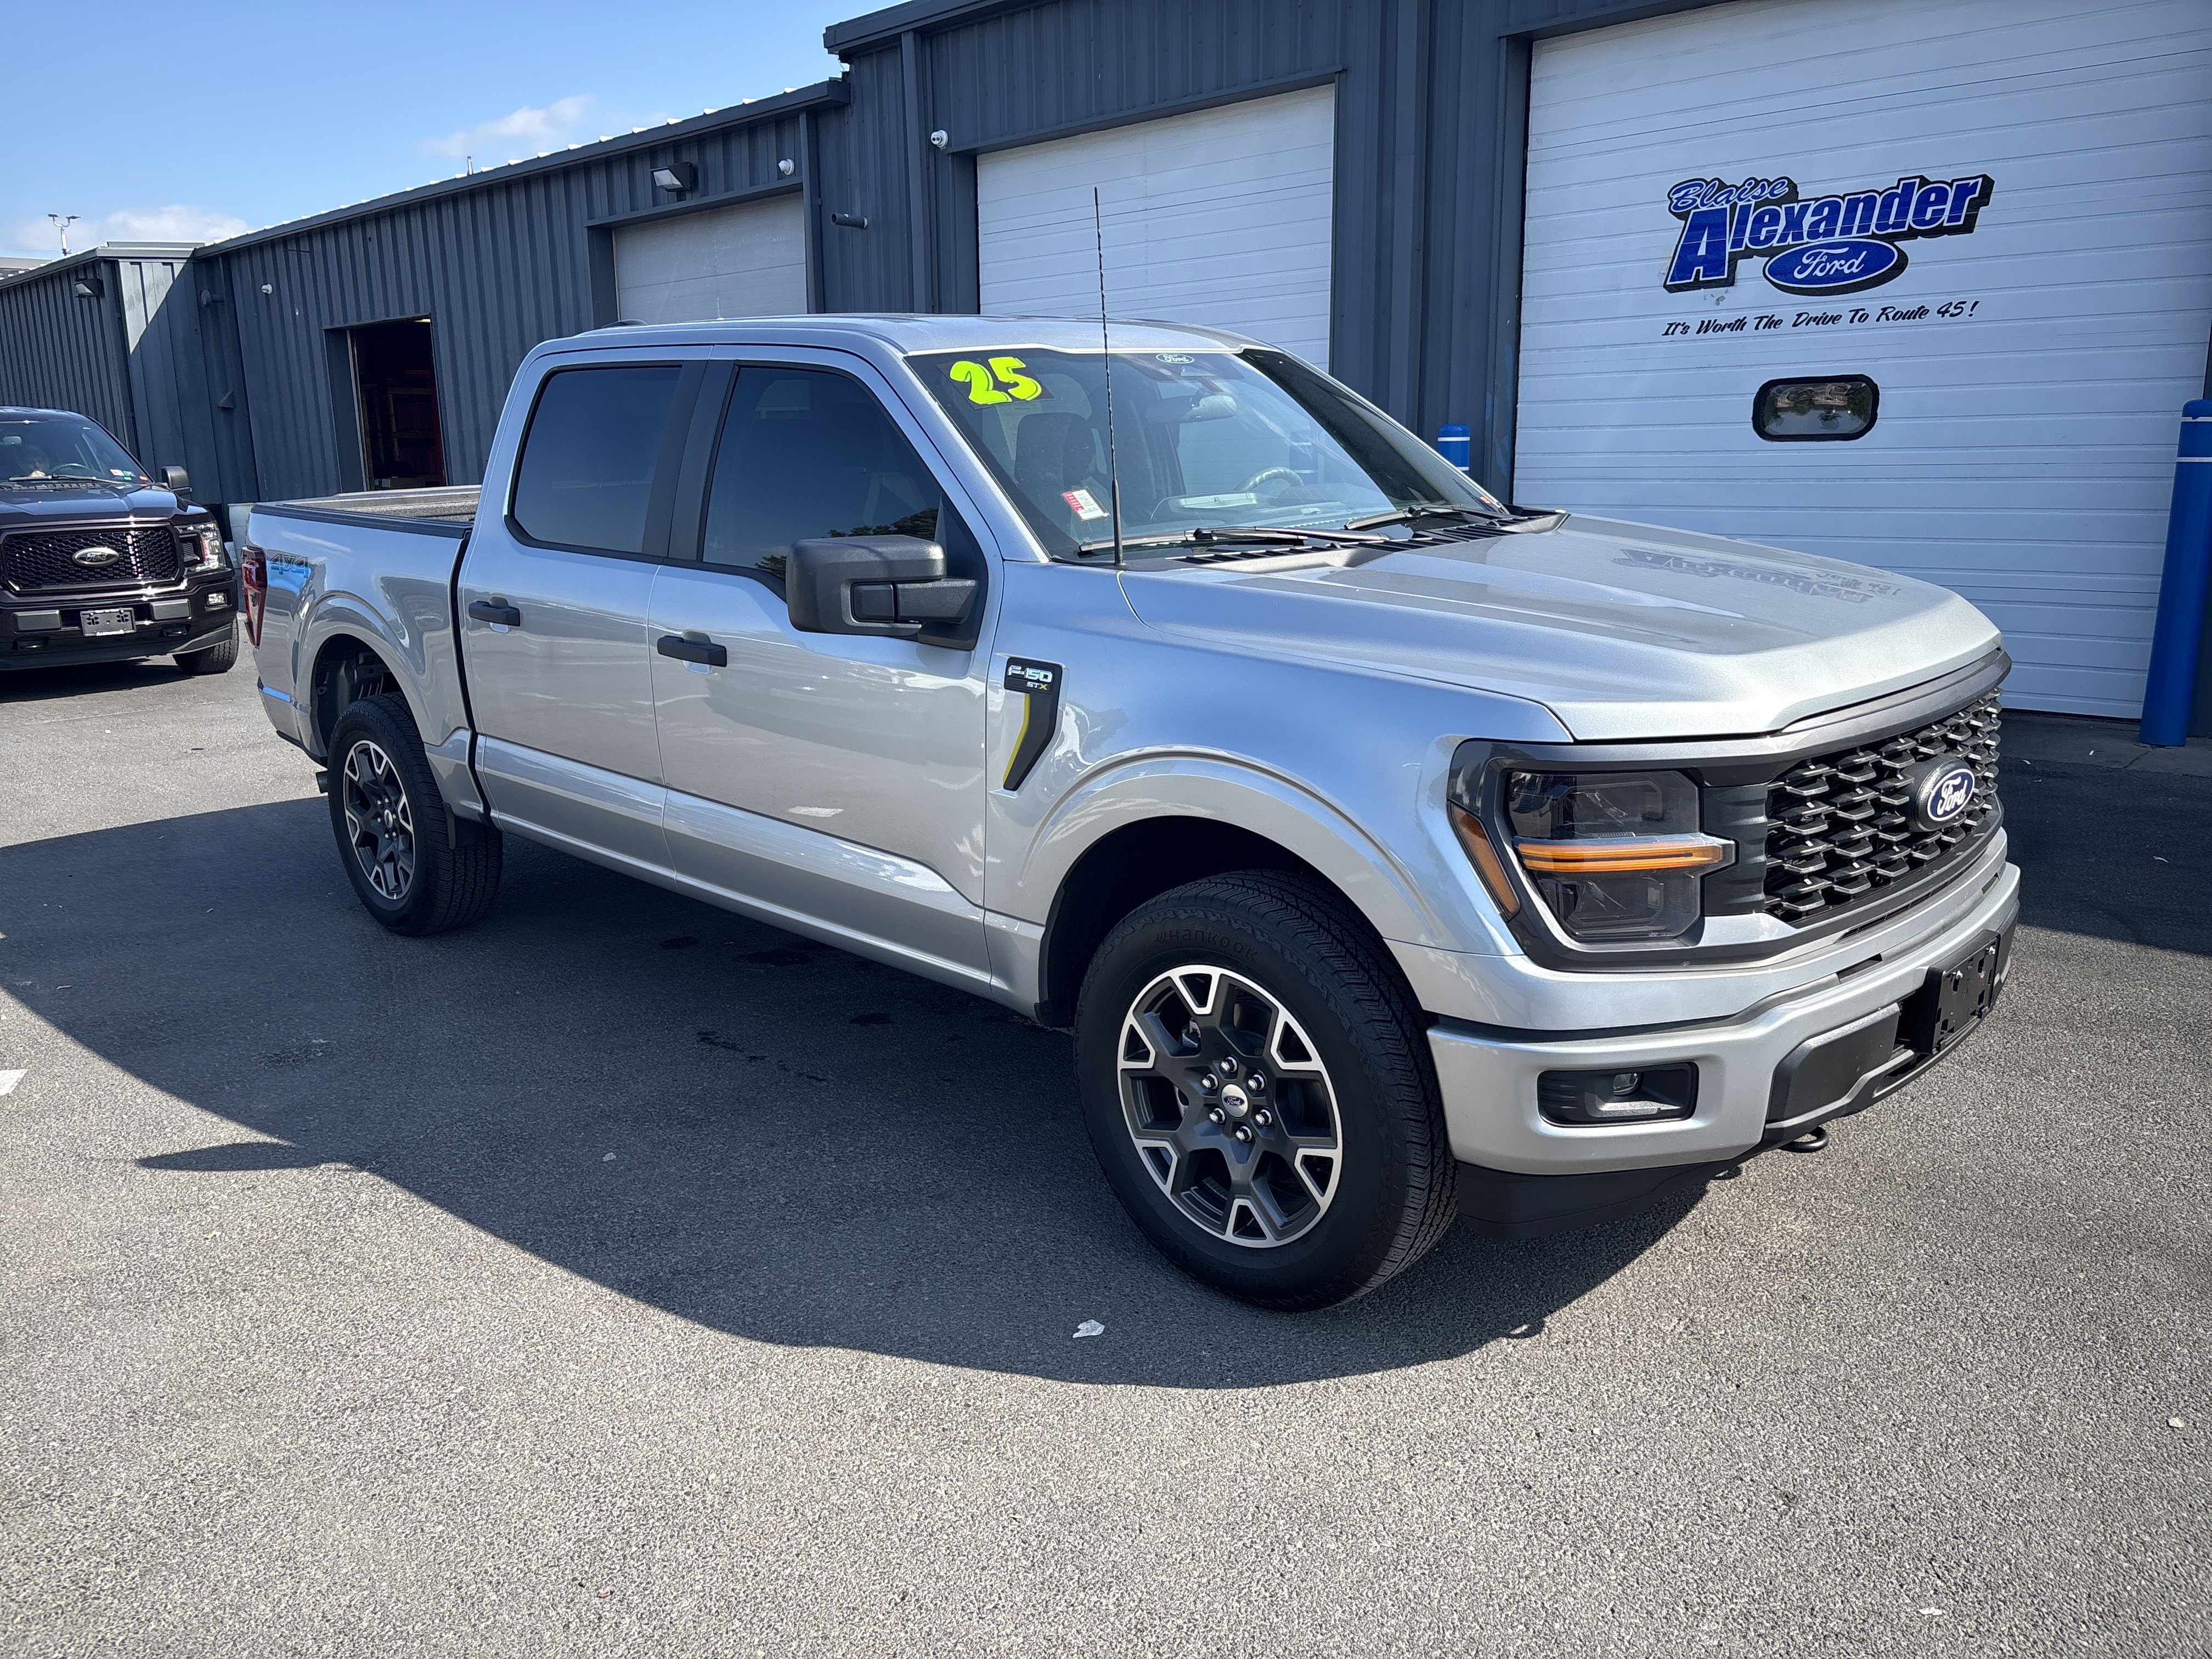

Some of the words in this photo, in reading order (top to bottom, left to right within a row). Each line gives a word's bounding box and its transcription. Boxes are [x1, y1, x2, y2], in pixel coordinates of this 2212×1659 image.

[1669, 178, 1789, 213] Blaise
[1666, 176, 1984, 286] Alexander
[1793, 245, 1867, 279] Ford
[1661, 321, 1691, 336] It's
[1695, 315, 1748, 335] Worth
[1753, 313, 1784, 331] The
[1791, 311, 1843, 329] Drive
[1848, 307, 1870, 324] To
[1875, 304, 1931, 323] Route
[949, 356, 1042, 405] 25
[86, 552, 108, 561] Ford
[1007, 664, 1053, 682] F-150
[1026, 681, 1048, 691] STX
[1936, 775, 1969, 816] Ford
[1226, 1097, 1242, 1106] Ford
